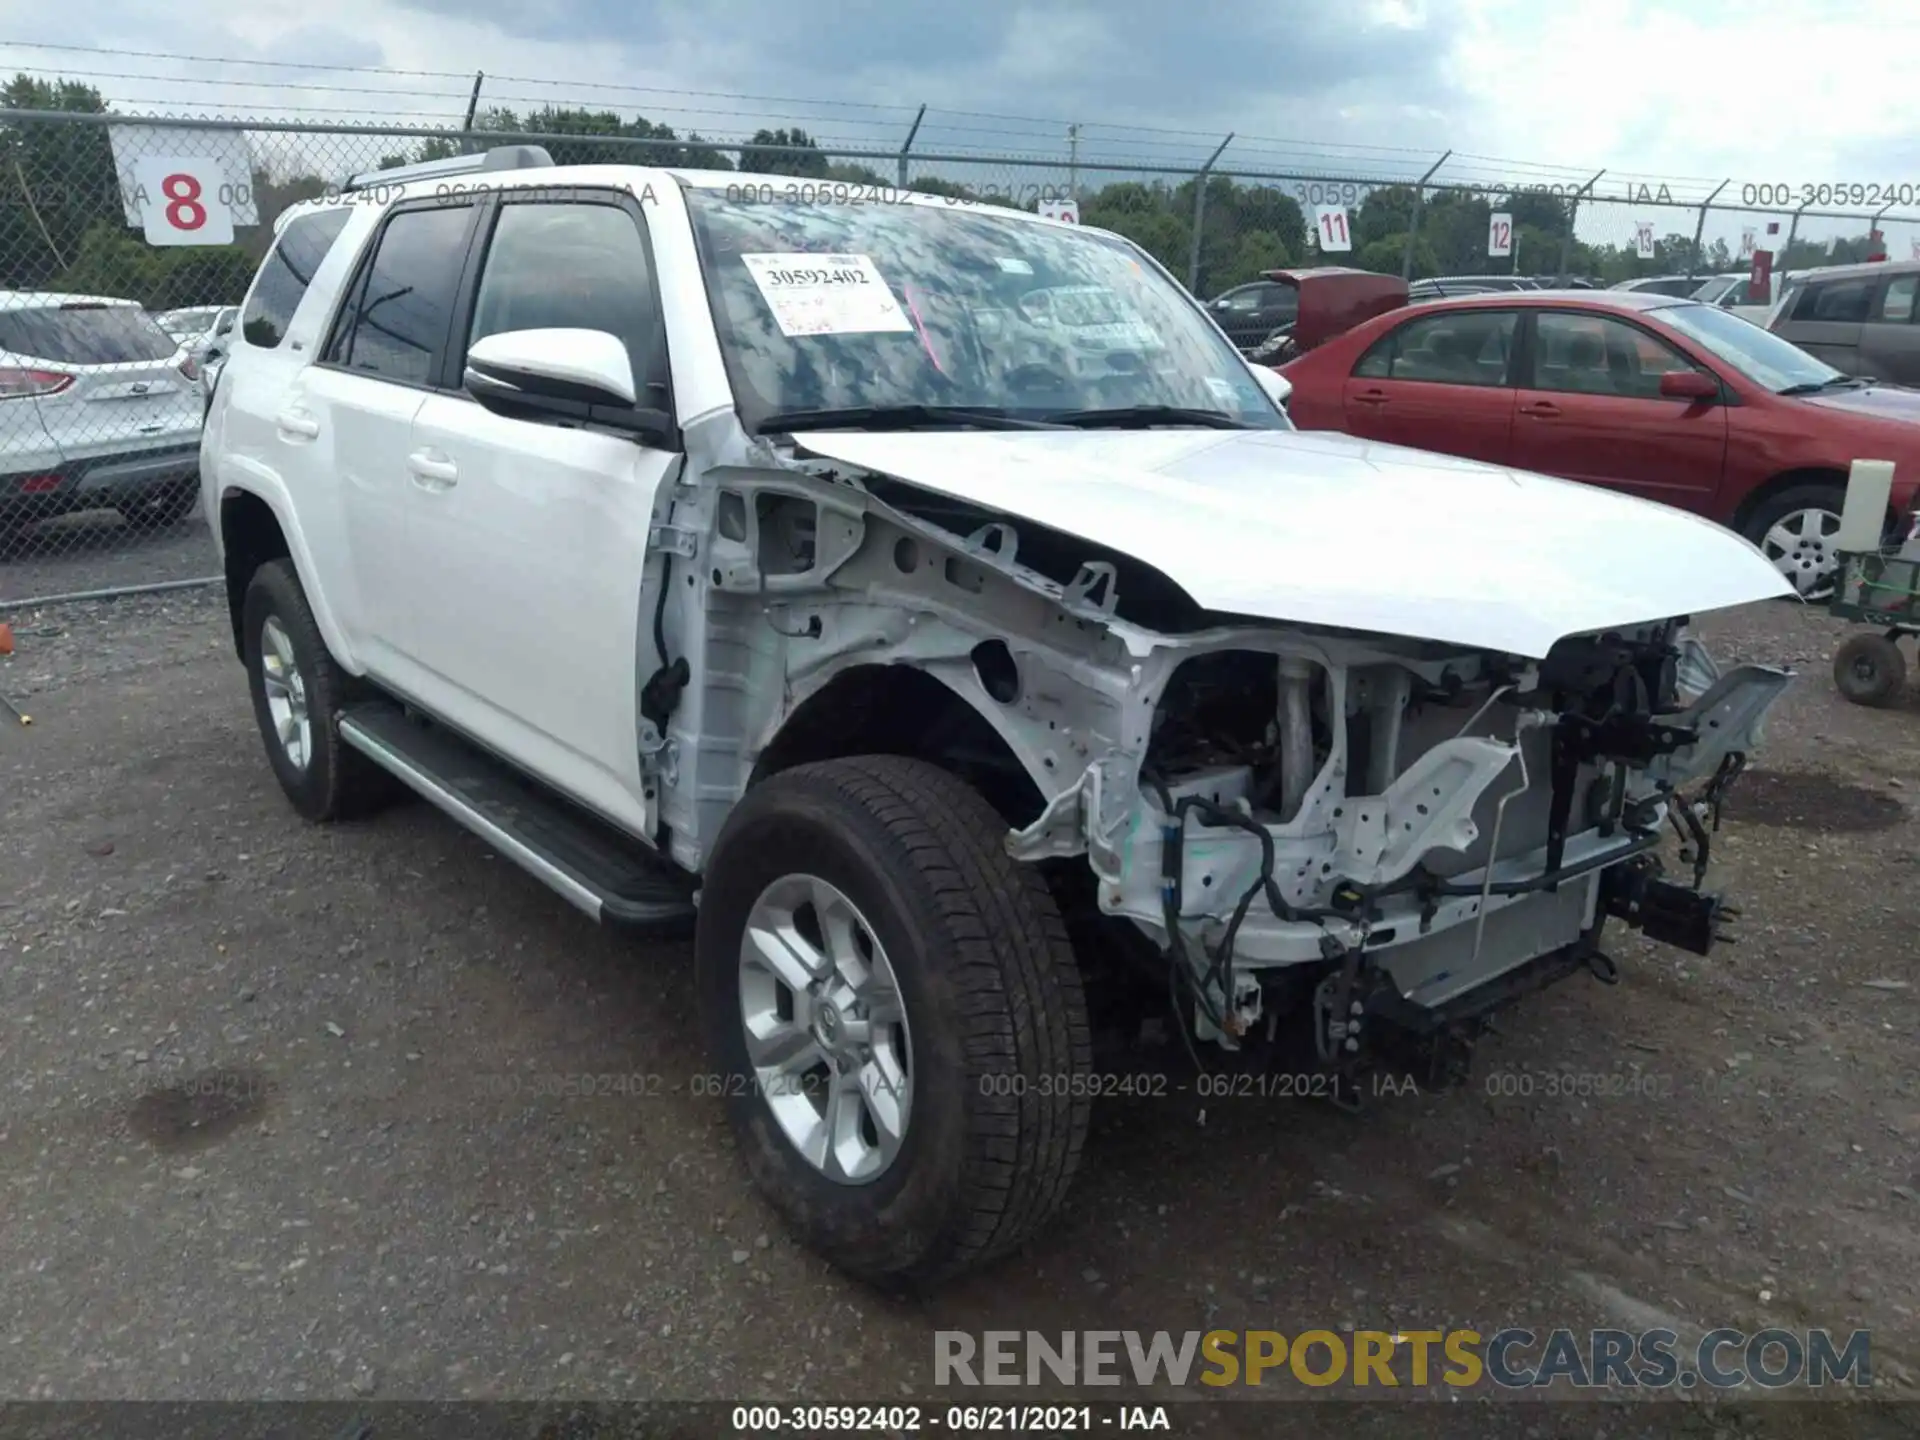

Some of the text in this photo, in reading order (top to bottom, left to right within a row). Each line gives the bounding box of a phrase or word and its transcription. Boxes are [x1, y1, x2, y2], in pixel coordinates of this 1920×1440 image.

[161, 173, 207, 231] 8
[1321, 213, 1347, 244] 11
[1492, 221, 1510, 249] 12
[1638, 228, 1652, 252] 13
[767, 270, 870, 286] 30592402
